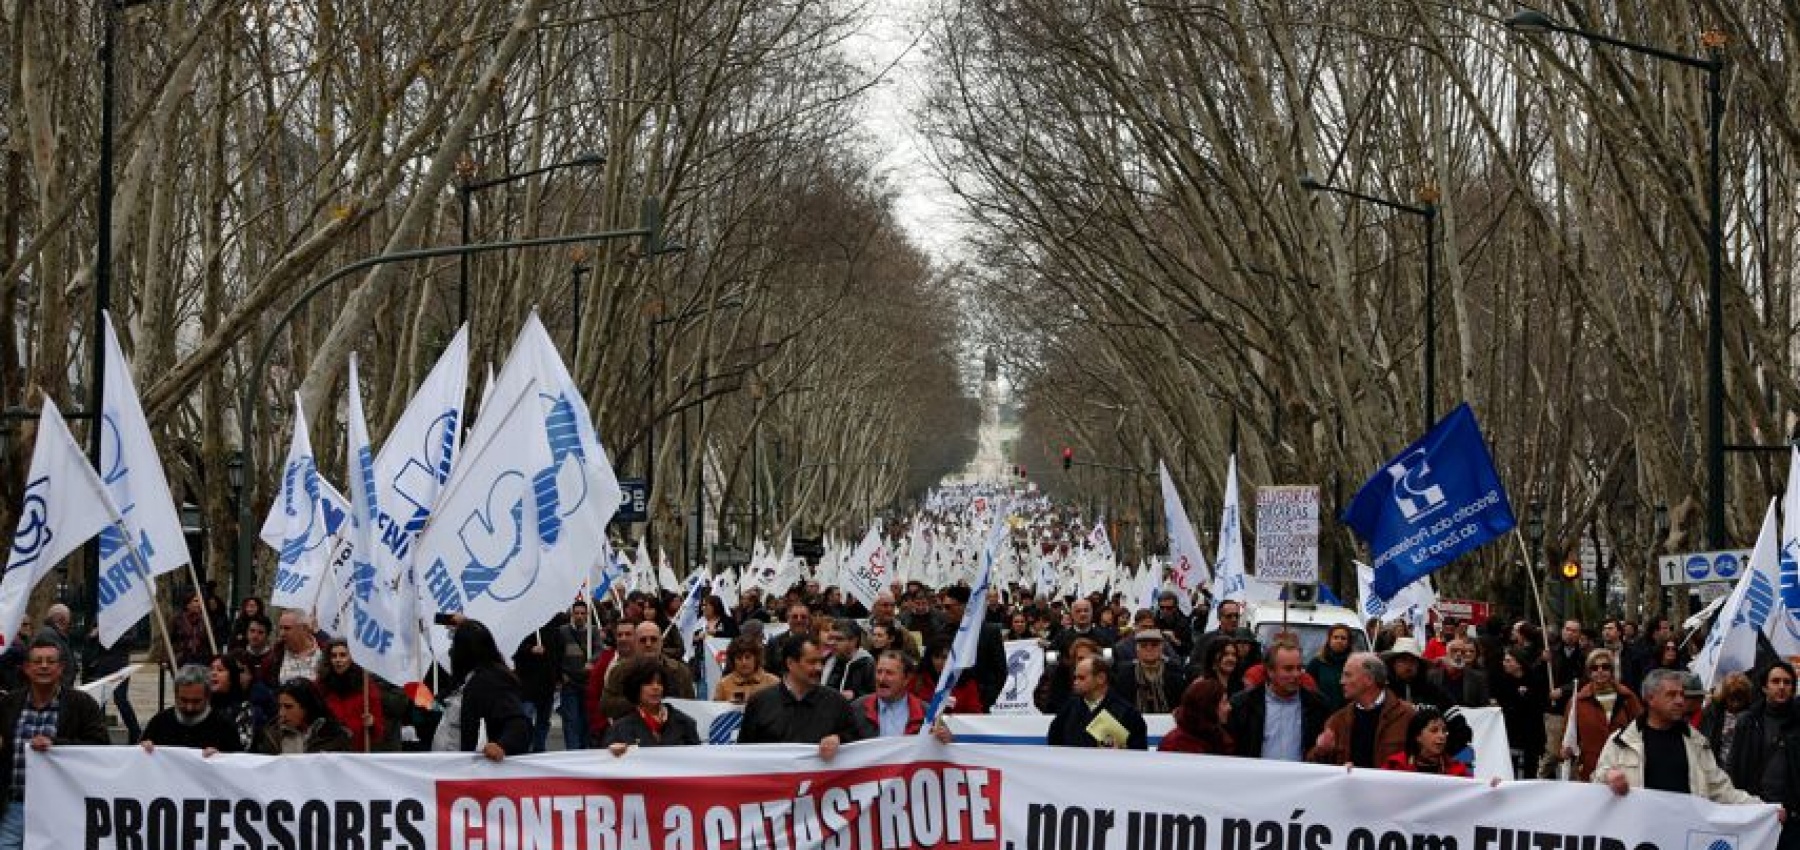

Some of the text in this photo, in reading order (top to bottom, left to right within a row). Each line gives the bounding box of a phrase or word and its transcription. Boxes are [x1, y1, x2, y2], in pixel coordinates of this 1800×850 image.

[84, 797, 426, 850] PROFESSORES
[452, 794, 652, 850] CONTRA
[663, 804, 694, 850] a
[704, 768, 996, 850] CATÁSTROFE
[1028, 803, 1115, 850] por
[1127, 811, 1207, 850] um
